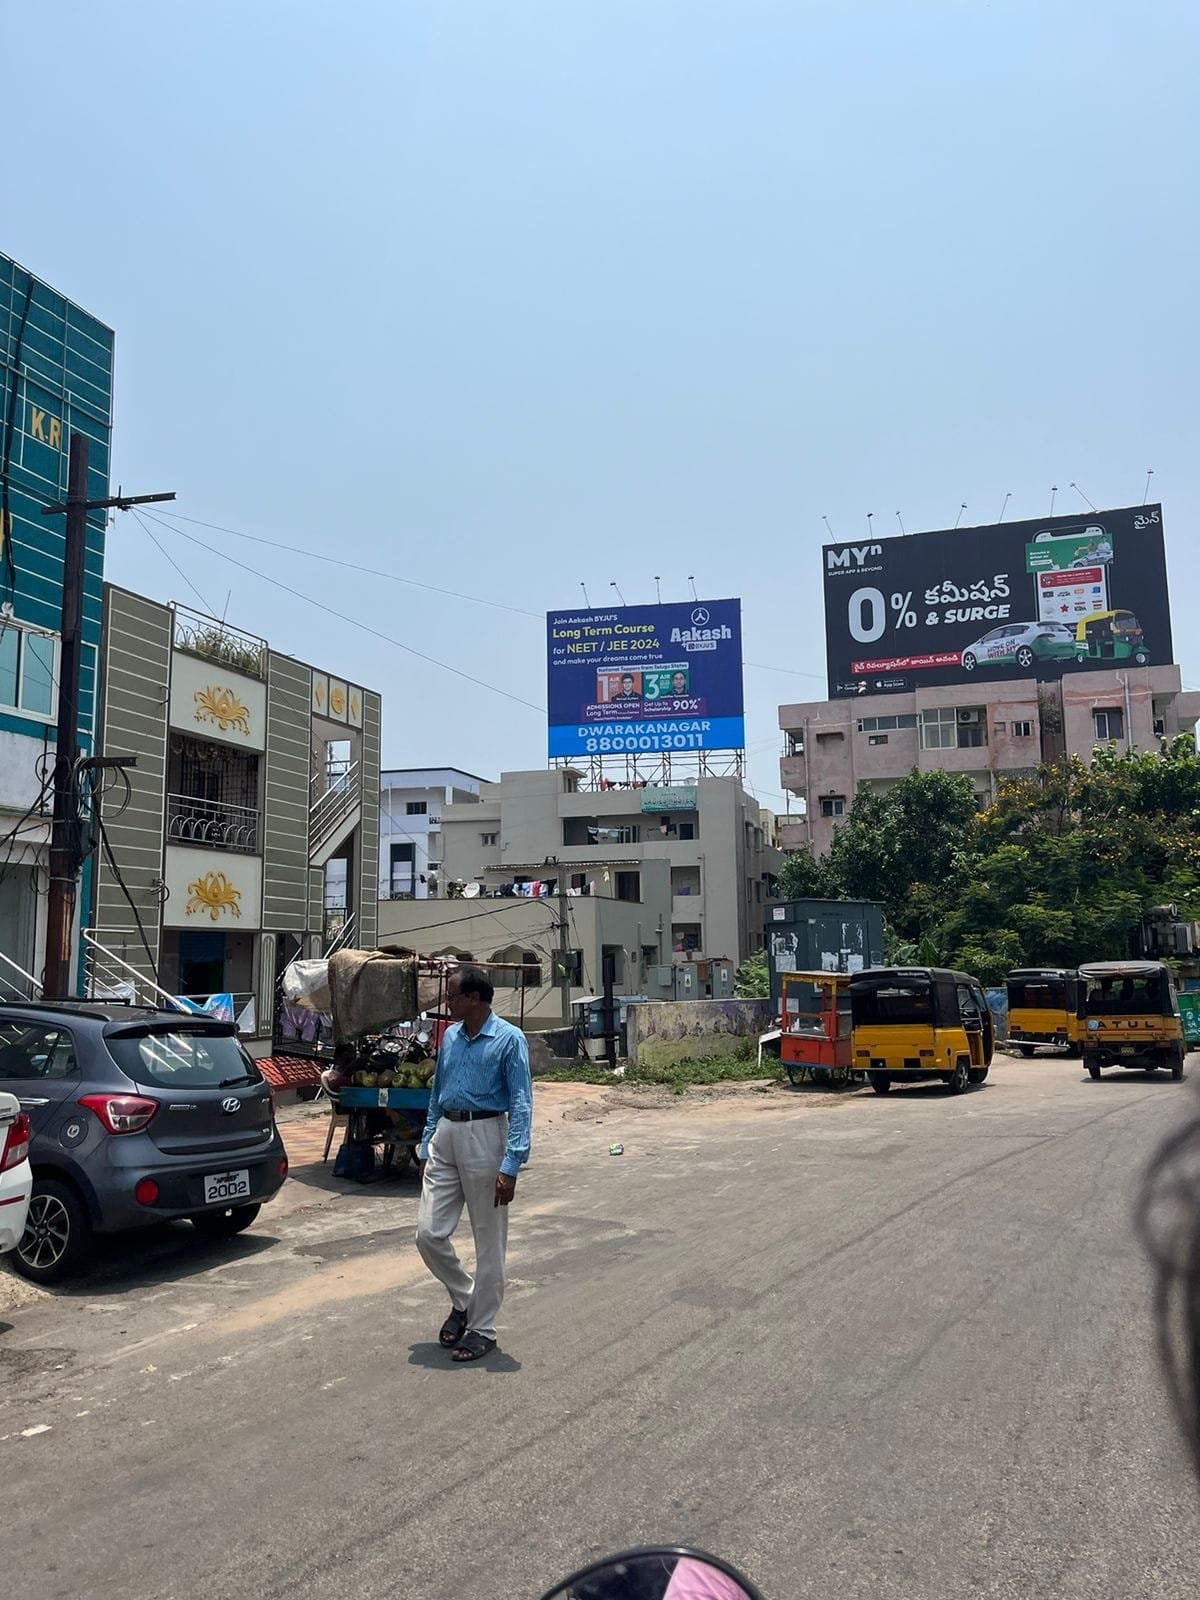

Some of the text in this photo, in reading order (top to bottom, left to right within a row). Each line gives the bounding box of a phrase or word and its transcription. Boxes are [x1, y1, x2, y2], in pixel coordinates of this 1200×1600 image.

[31, 406, 61, 448] K.R
[1134, 511, 1159, 530] మైన్
[568, 616, 593, 624] Aakash
[925, 604, 1011, 626] & SURGE
[553, 624, 655, 639] Long Term Course
[670, 624, 732, 643] Aakash
[553, 647, 565, 655] for
[567, 642, 599, 654] NEET
[607, 640, 628, 651] JEE
[630, 638, 660, 650] 2024
[587, 657, 602, 665] your
[645, 674, 660, 699] 3
[578, 721, 711, 738] DWARAKANAGAR
[586, 733, 703, 752] 8800013011
[1097, 1020, 1154, 1029] ATUL
[208, 1181, 247, 1199] 2002
